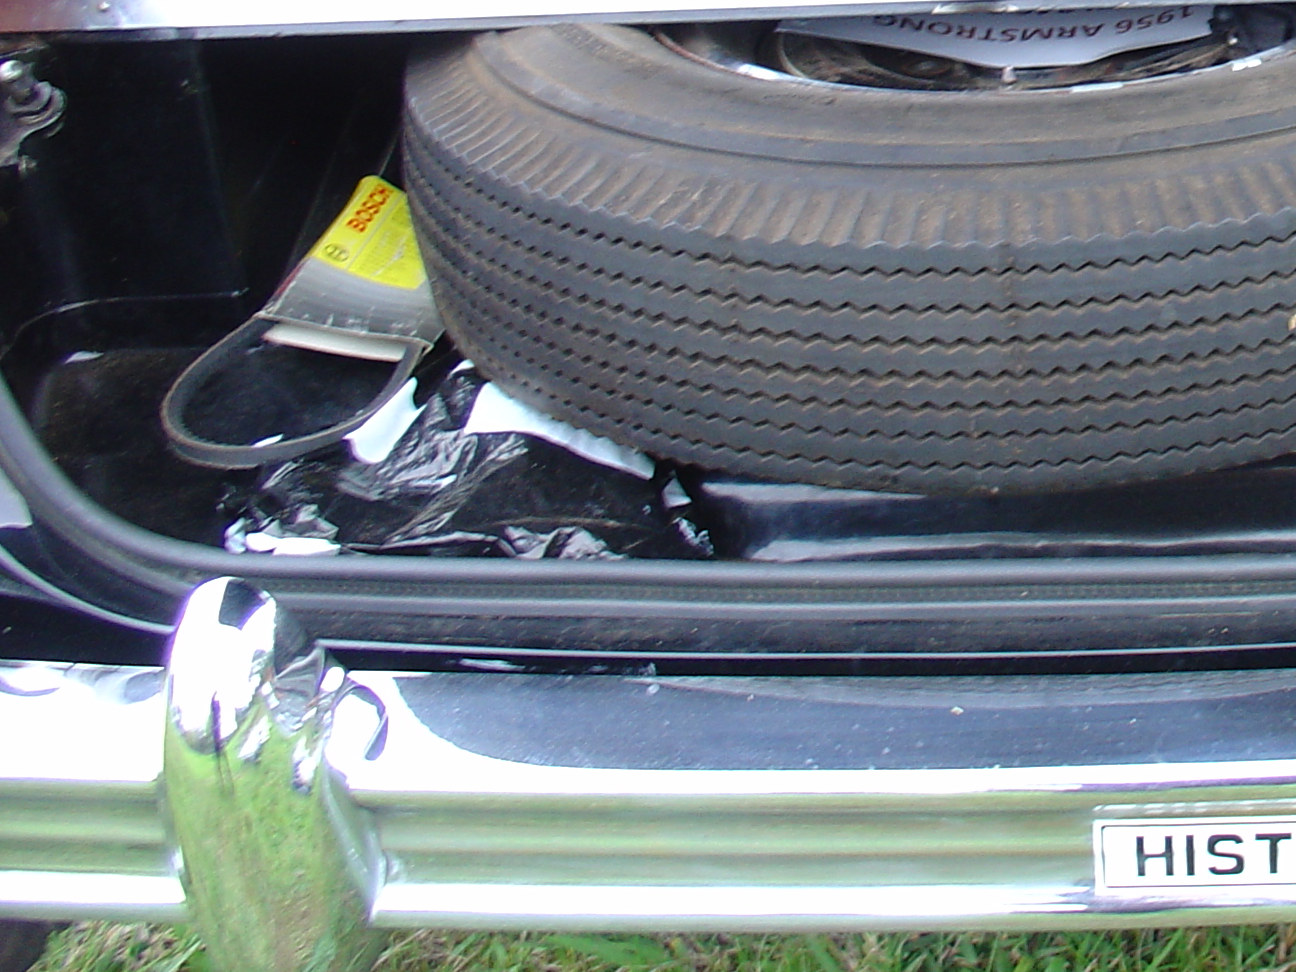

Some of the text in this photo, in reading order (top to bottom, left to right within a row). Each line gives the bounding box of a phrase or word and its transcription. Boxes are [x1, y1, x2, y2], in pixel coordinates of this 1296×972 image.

[872, 6, 1194, 42] 1956 ARMSTRONG
[345, 183, 395, 233] BOSCH
